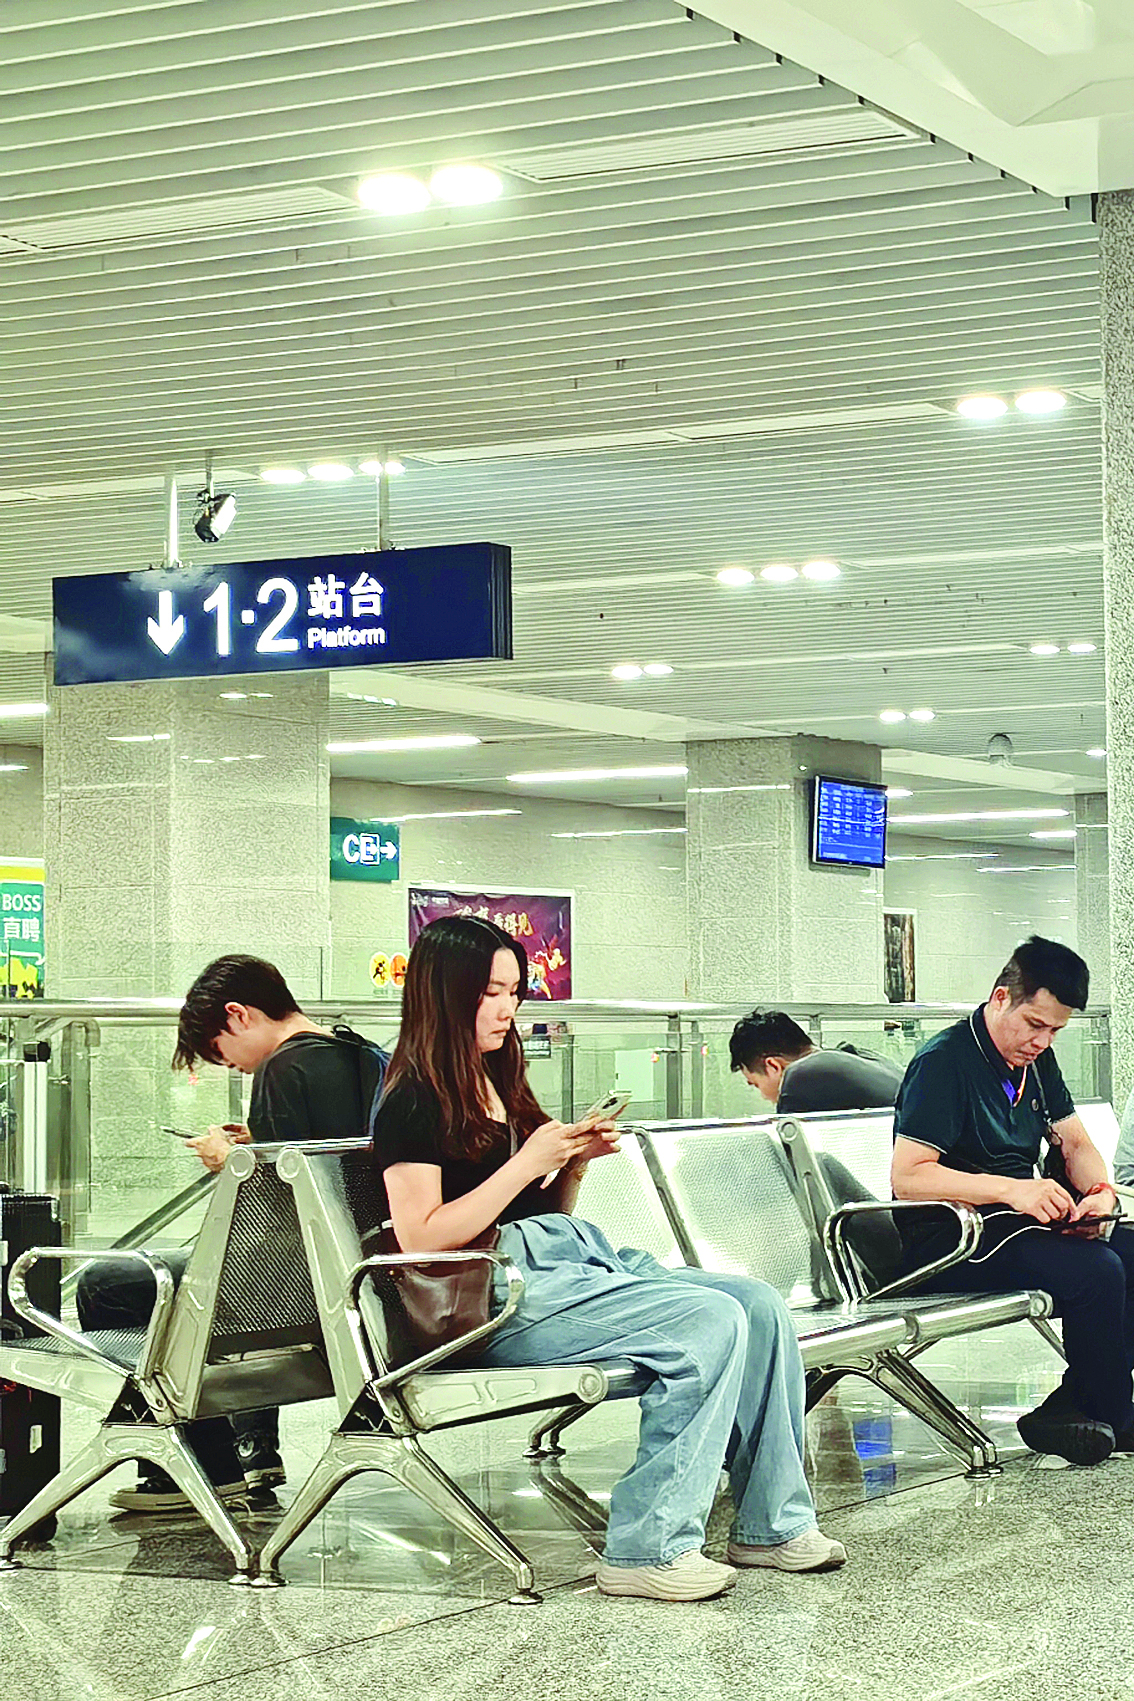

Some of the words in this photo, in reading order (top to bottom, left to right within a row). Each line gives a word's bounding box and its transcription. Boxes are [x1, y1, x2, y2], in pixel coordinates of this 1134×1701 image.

[307, 572, 385, 619] 站台
[307, 625, 386, 649] Platform
[2, 893, 42, 912] BOSS
[3, 916, 40, 942] 直聘
